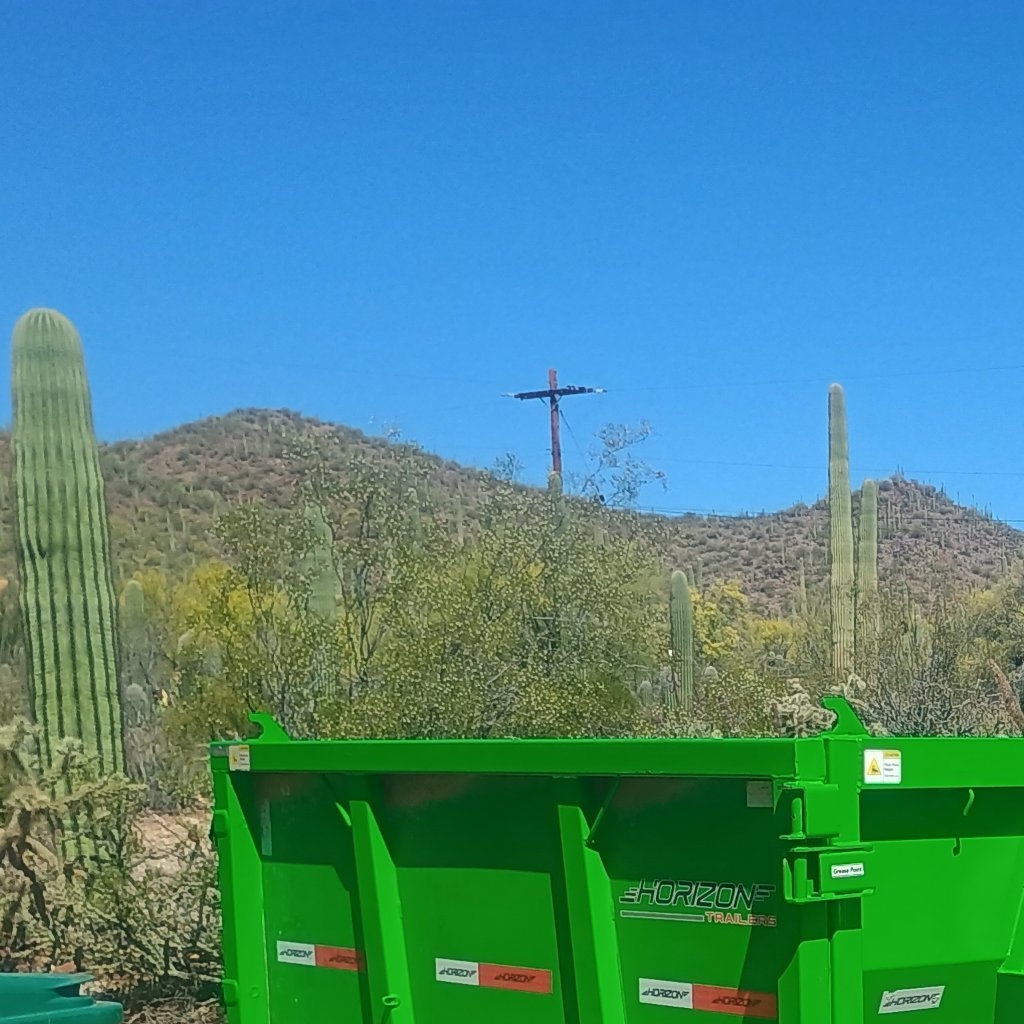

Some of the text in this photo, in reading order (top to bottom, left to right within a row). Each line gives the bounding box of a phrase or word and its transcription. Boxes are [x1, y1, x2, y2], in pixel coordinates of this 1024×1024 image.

[619, 879, 776, 911] HORIZON
[704, 911, 777, 927] TRAILERS
[438, 967, 477, 978] HORIZON
[641, 988, 690, 999] HORIZON
[883, 993, 940, 1007] HORIZON
